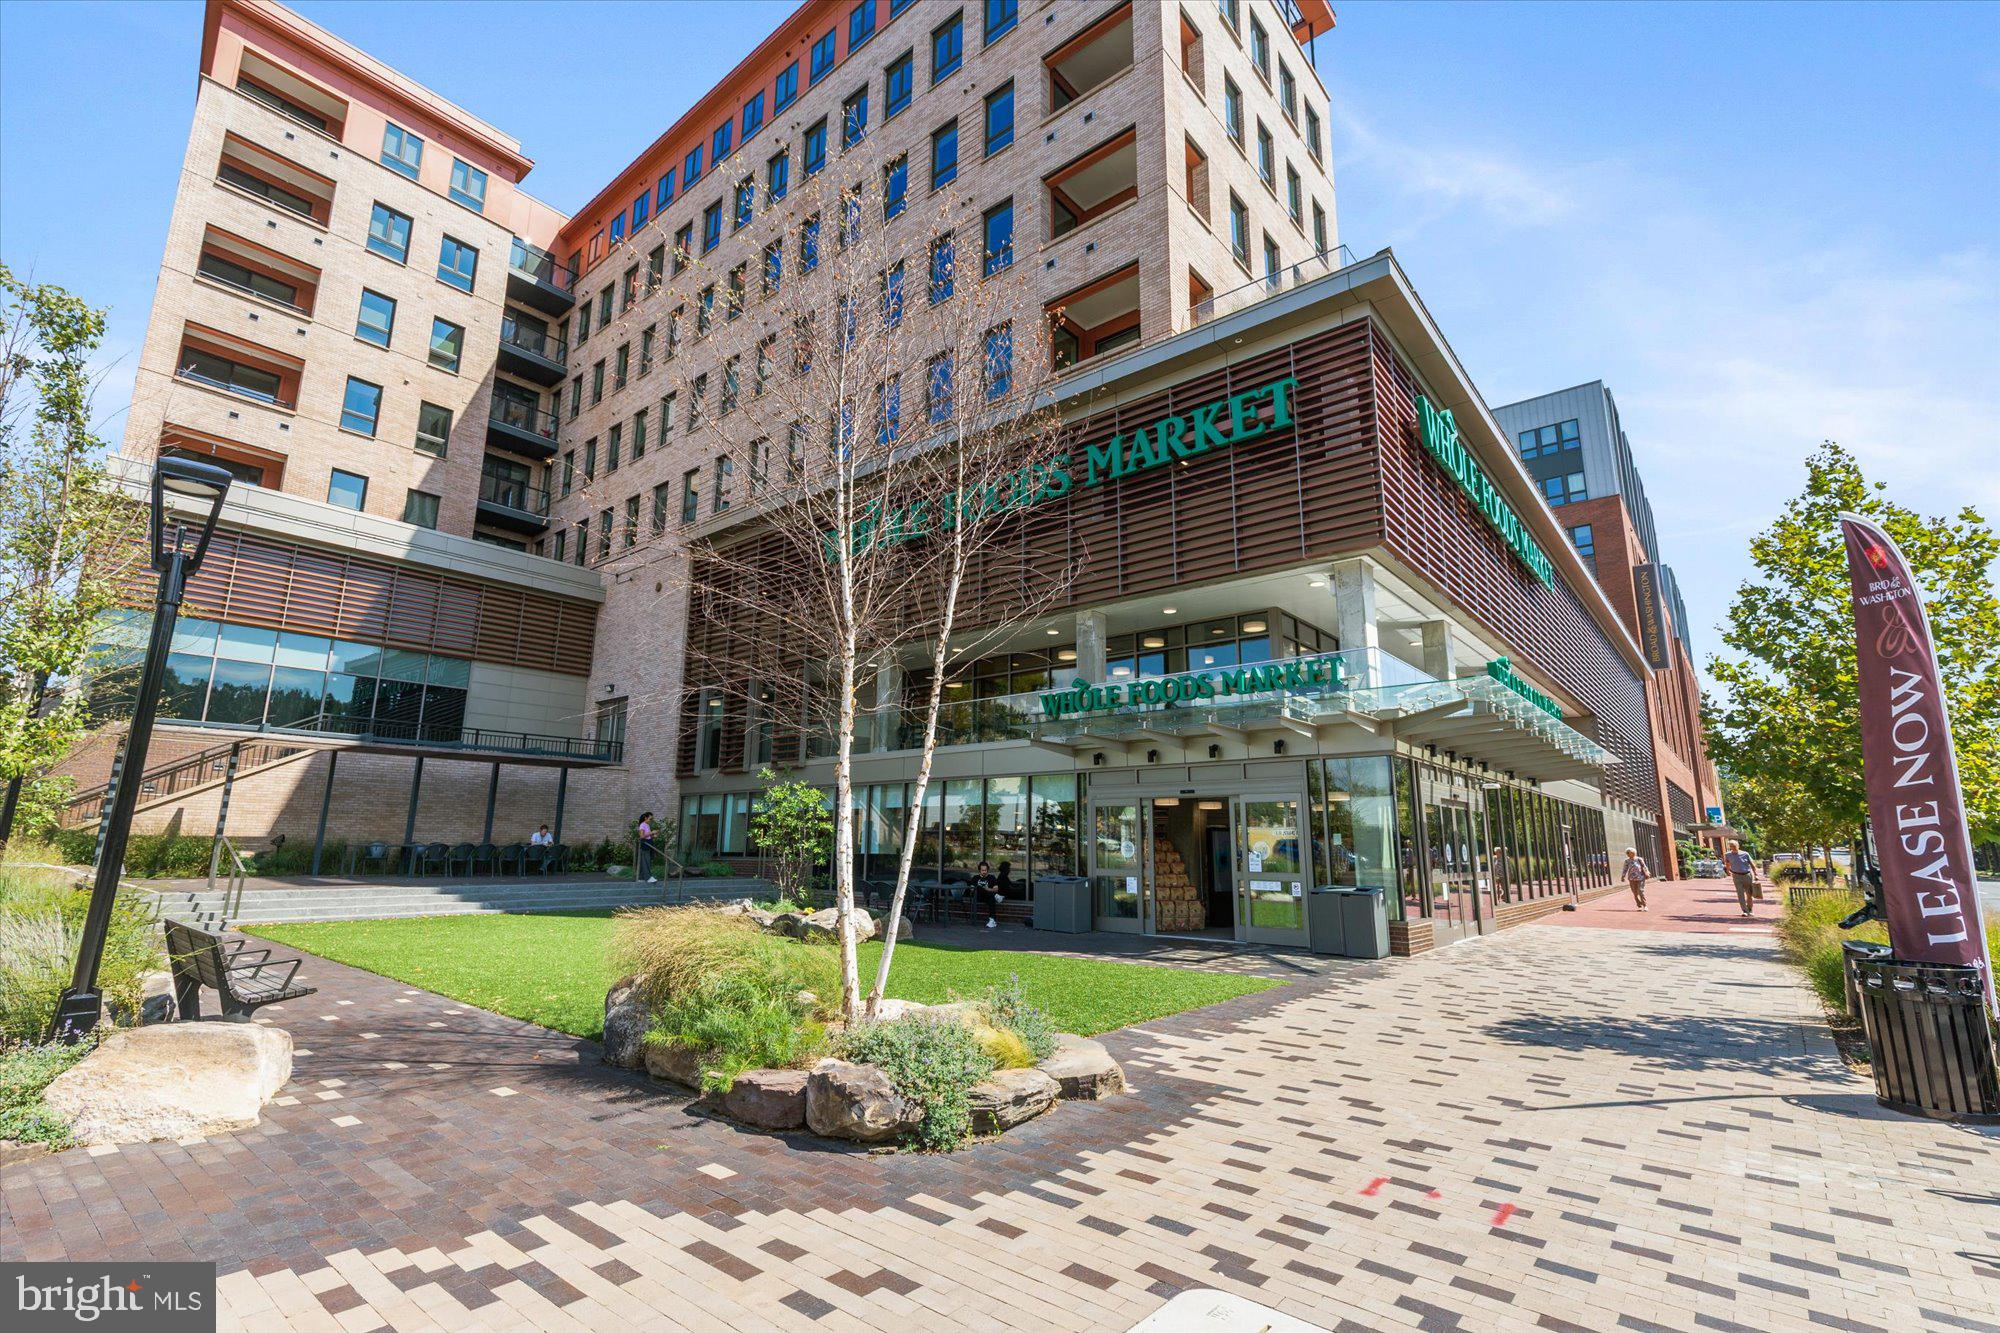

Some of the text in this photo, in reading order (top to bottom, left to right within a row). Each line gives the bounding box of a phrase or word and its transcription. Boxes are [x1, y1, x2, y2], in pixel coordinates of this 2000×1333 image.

[1083, 377, 1299, 488] MARKET
[1415, 395, 1481, 503] WHOLE
[1477, 472, 1520, 551] FOODS
[1890, 576, 1901, 589] &
[1039, 656, 1347, 716] WHOLE FOODS MARKET
[1649, 634, 1661, 662] BROAD
[1889, 666, 1969, 947] LEASE NOW
